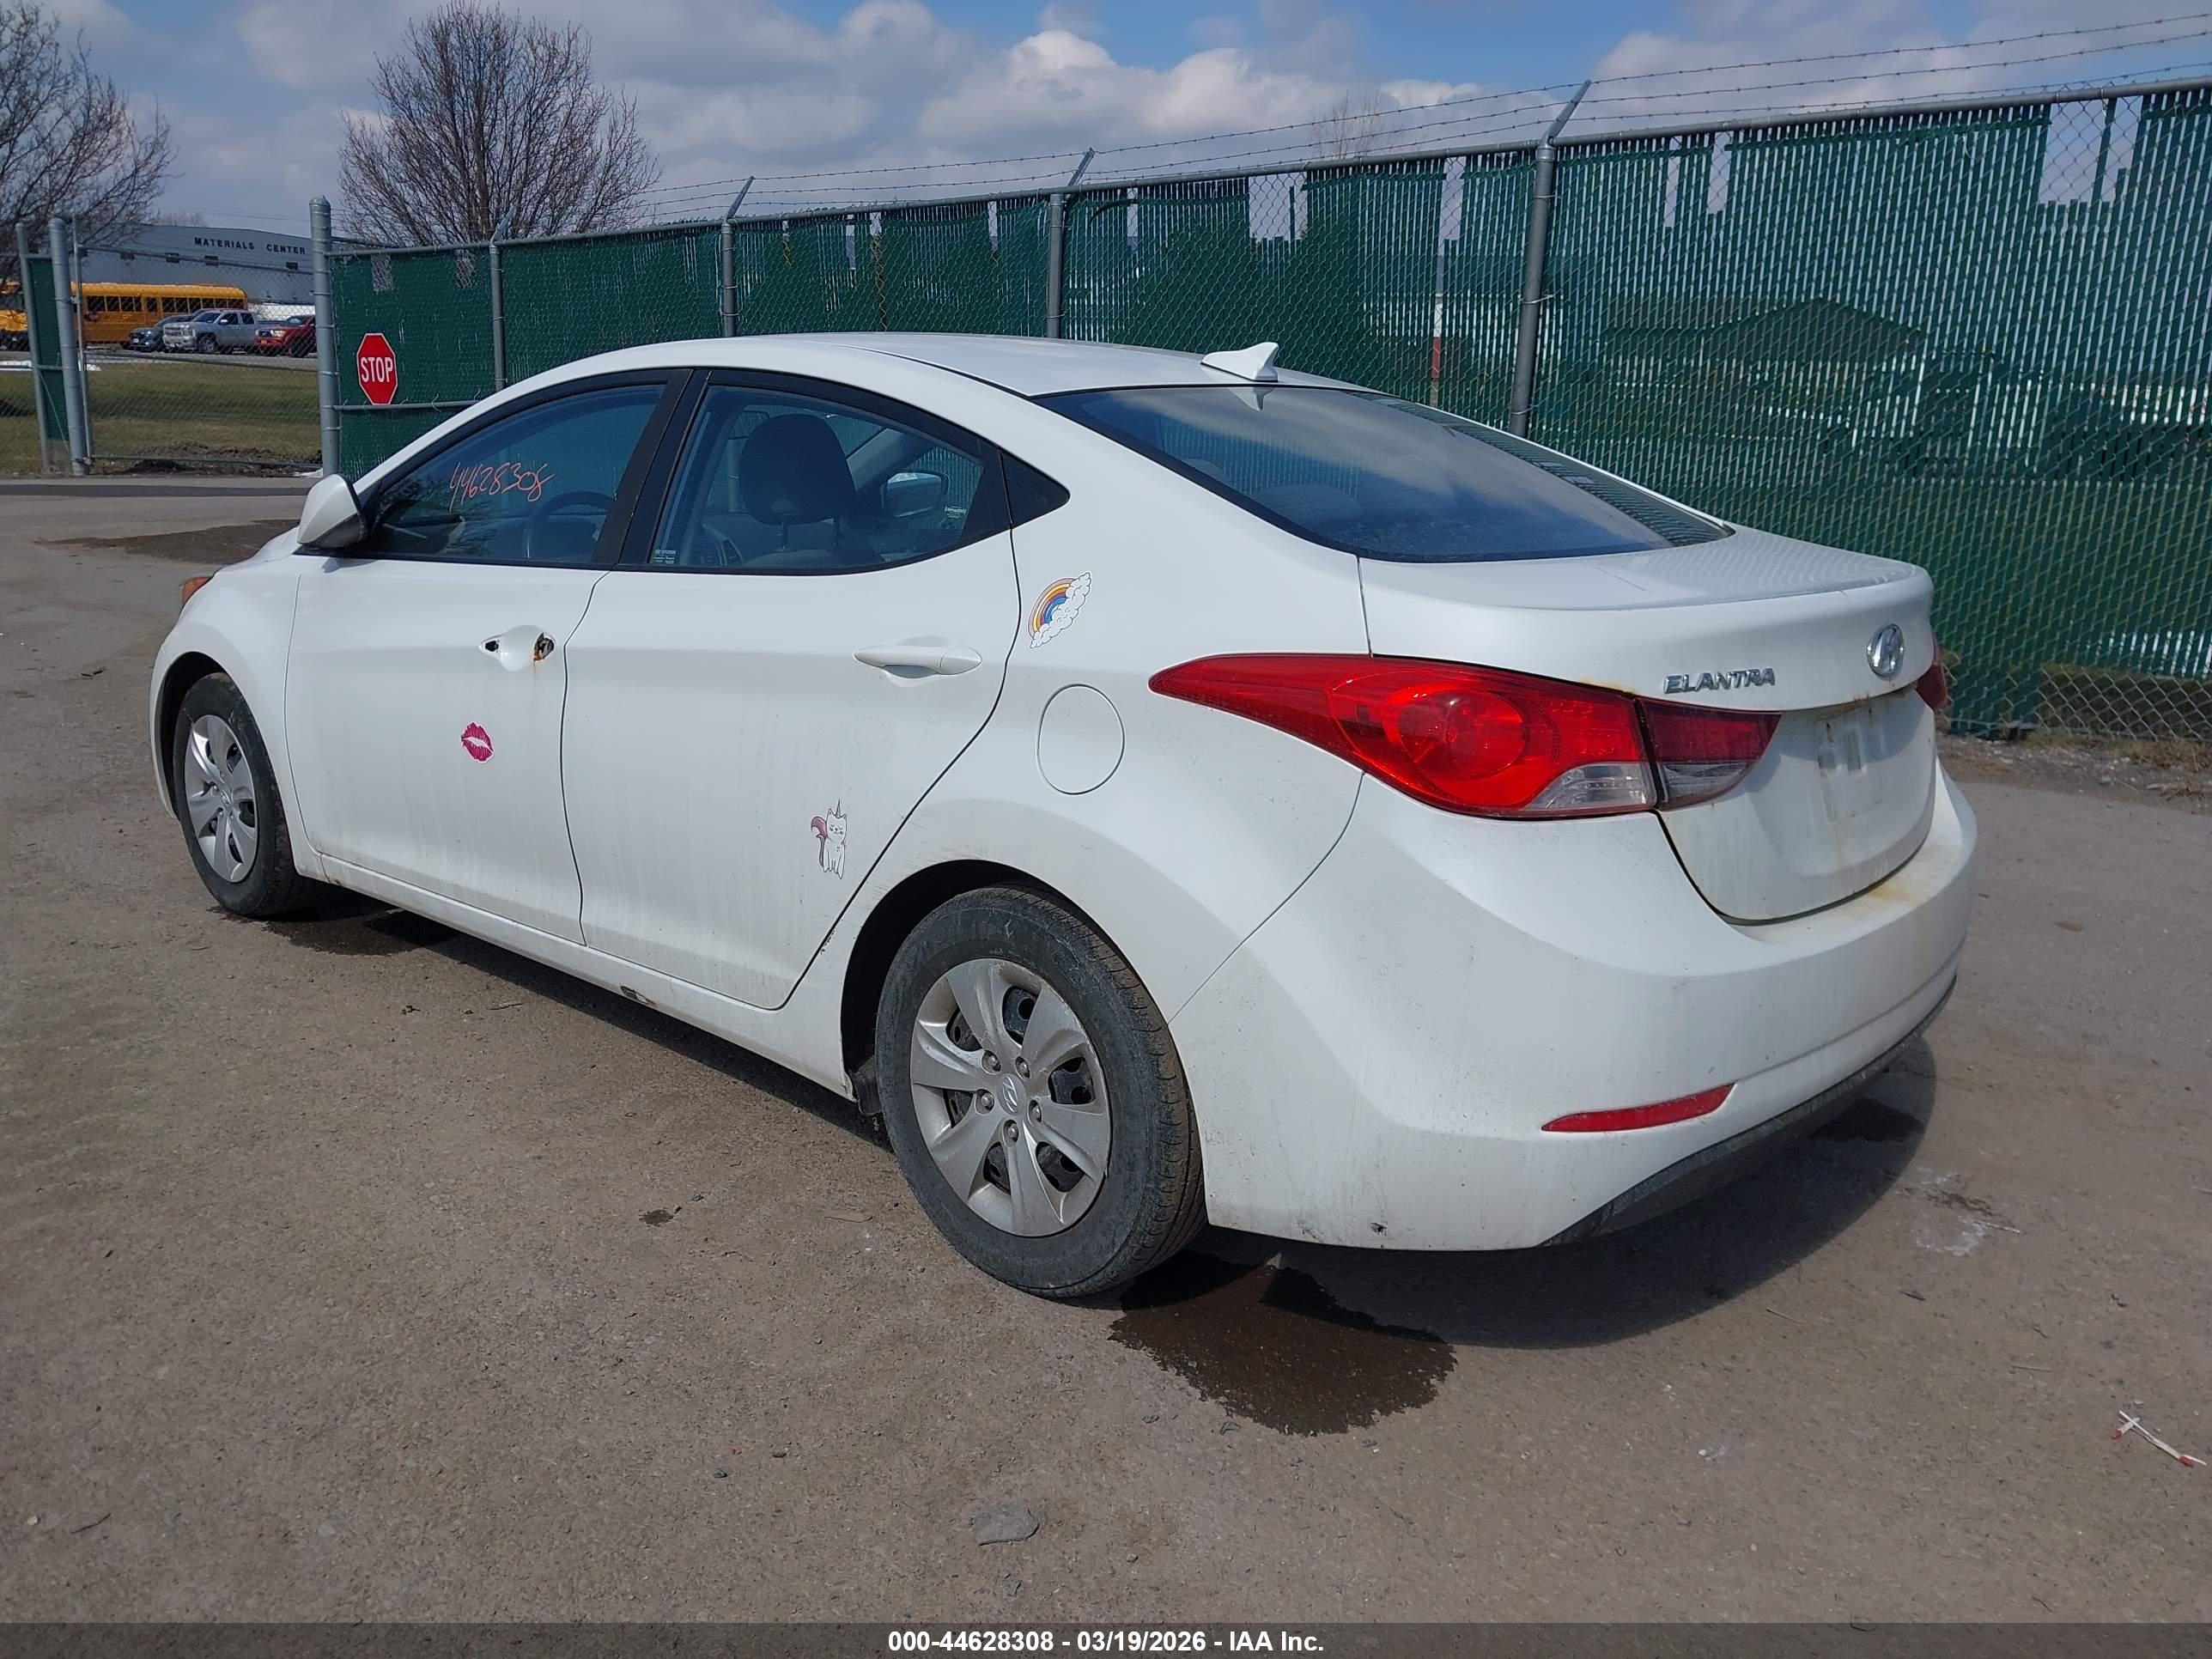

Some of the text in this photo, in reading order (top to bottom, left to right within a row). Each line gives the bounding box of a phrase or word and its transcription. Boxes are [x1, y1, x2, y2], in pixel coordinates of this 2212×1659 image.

[194, 237, 306, 255] MATERIALS CENTER
[361, 356, 393, 383] STOP
[449, 462, 556, 514] 44628308
[1663, 667, 1776, 694] ELANTRA
